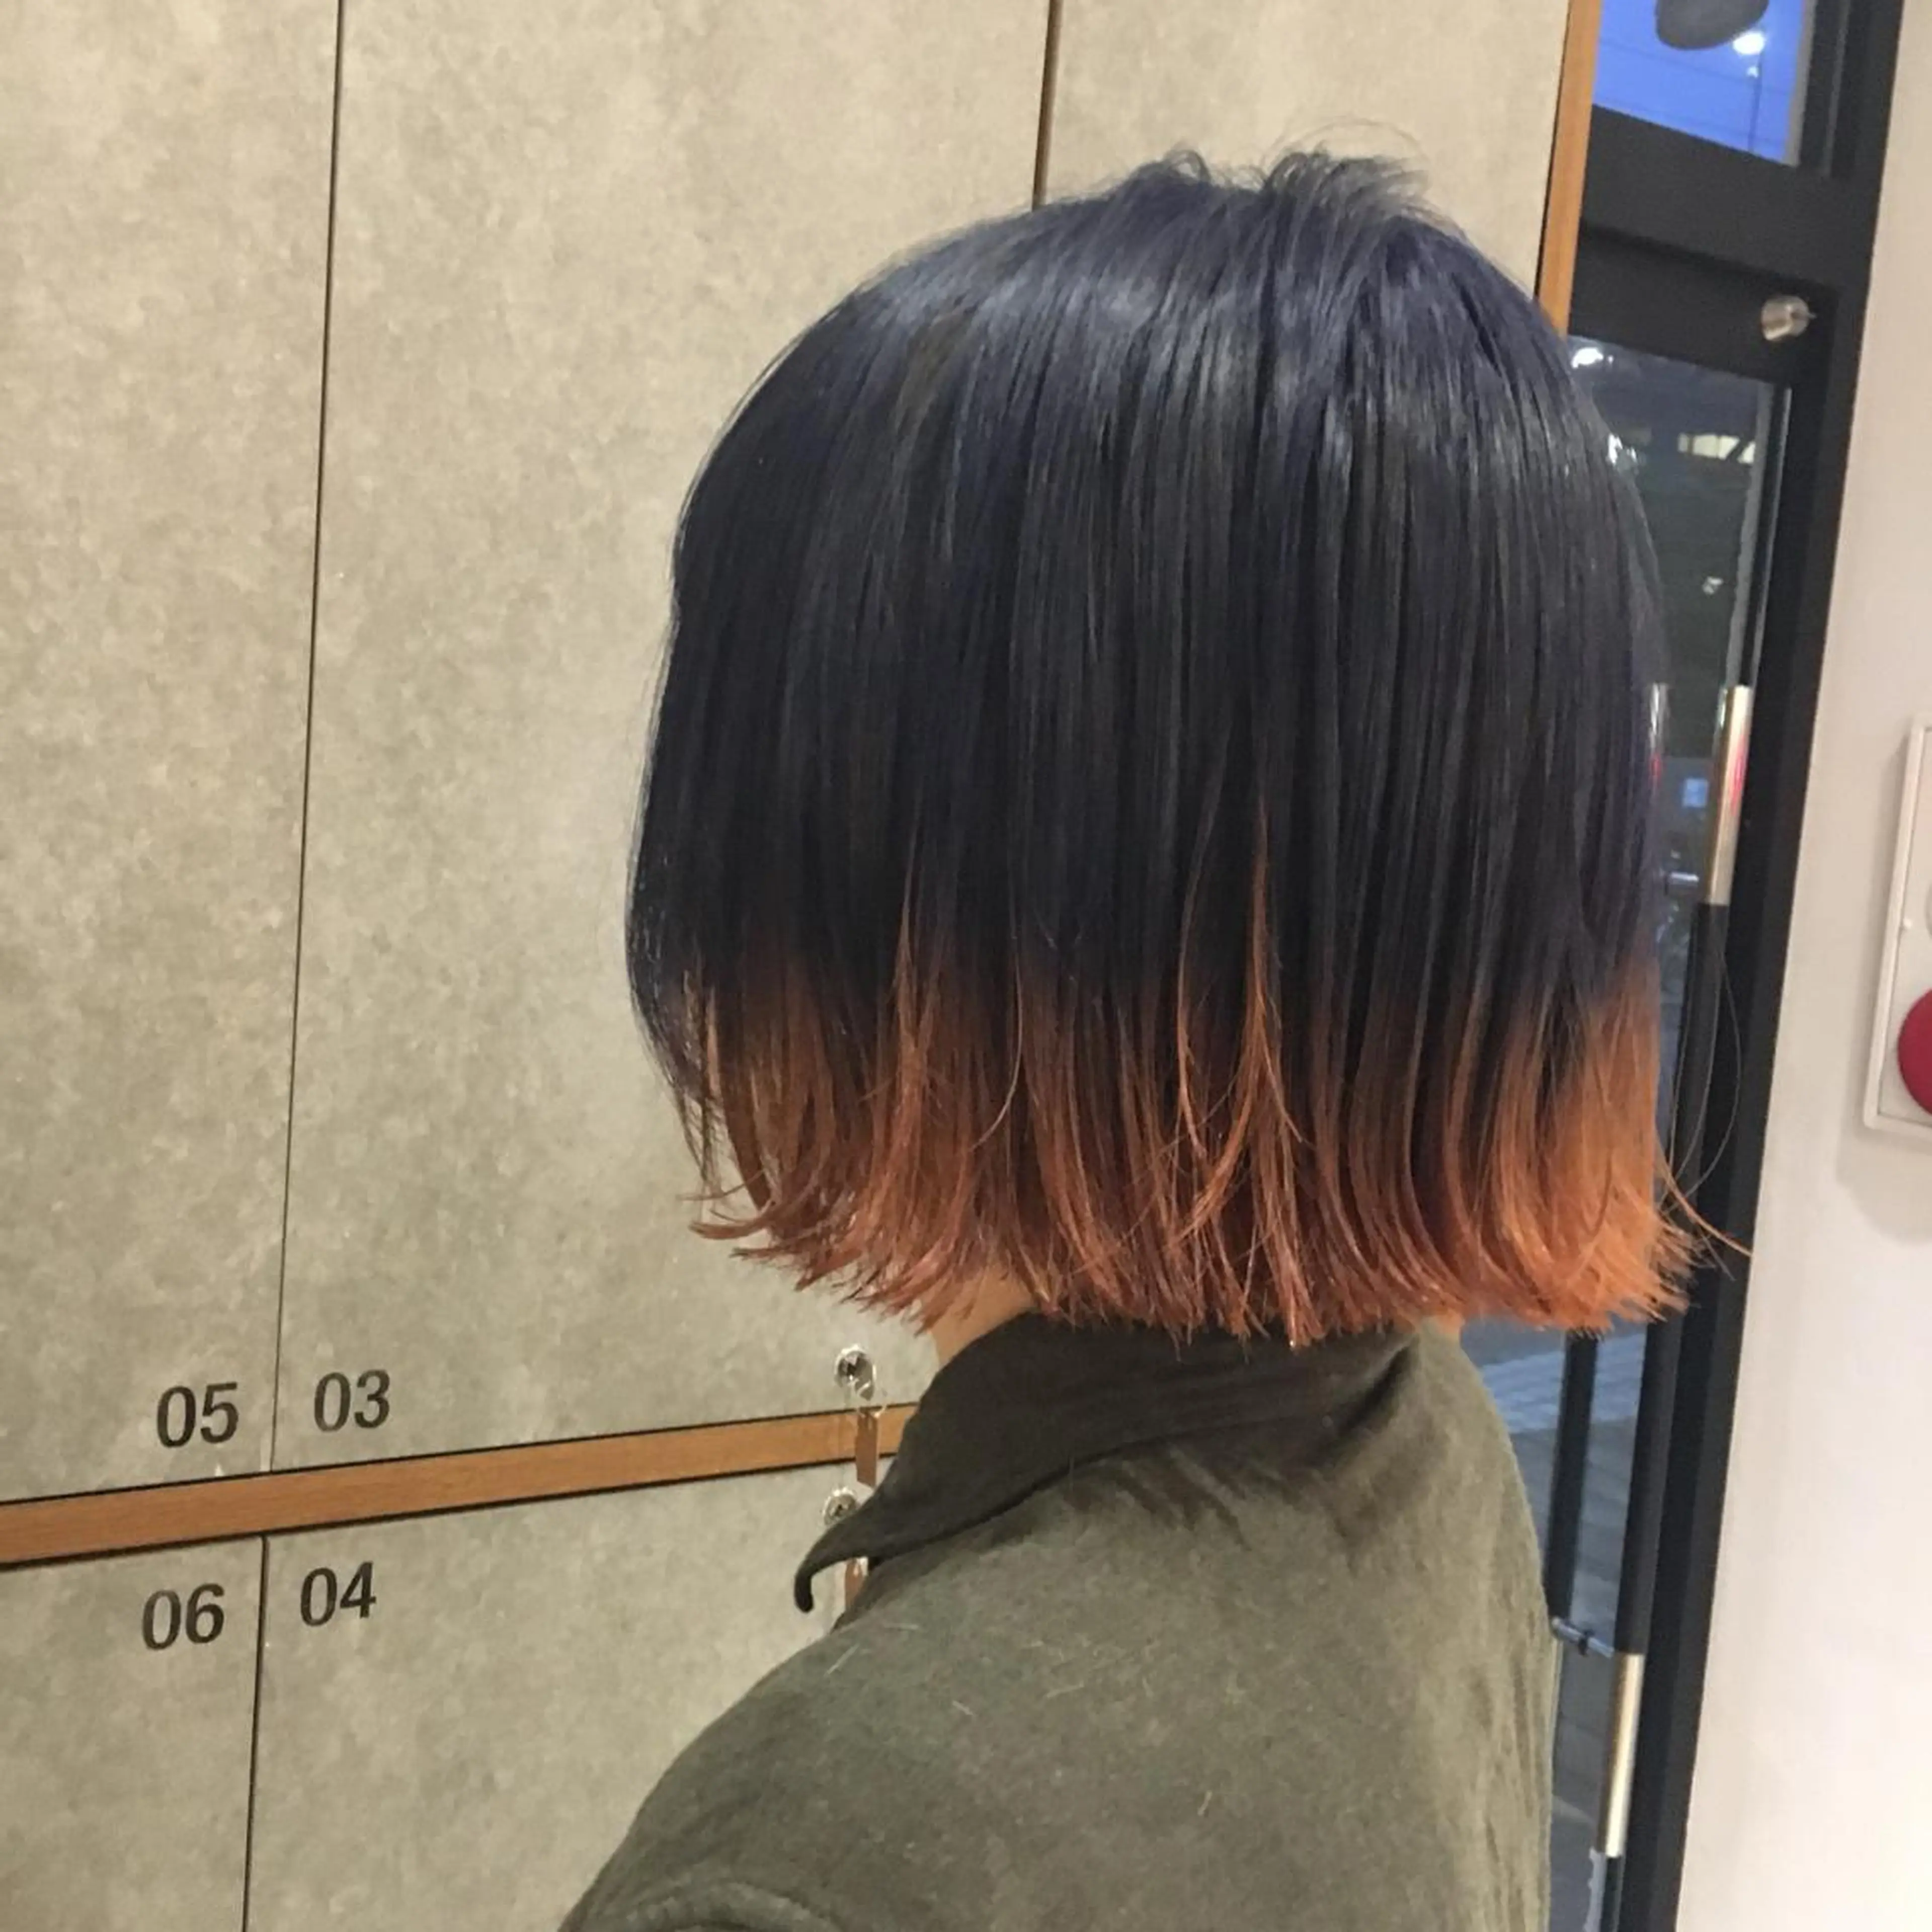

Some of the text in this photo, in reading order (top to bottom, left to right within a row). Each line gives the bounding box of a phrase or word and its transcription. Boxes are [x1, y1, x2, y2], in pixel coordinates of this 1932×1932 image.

[156, 1381, 239, 1448] 05
[313, 1369, 391, 1432] 03
[141, 1582, 225, 1651] 06
[300, 1561, 377, 1627] 04
